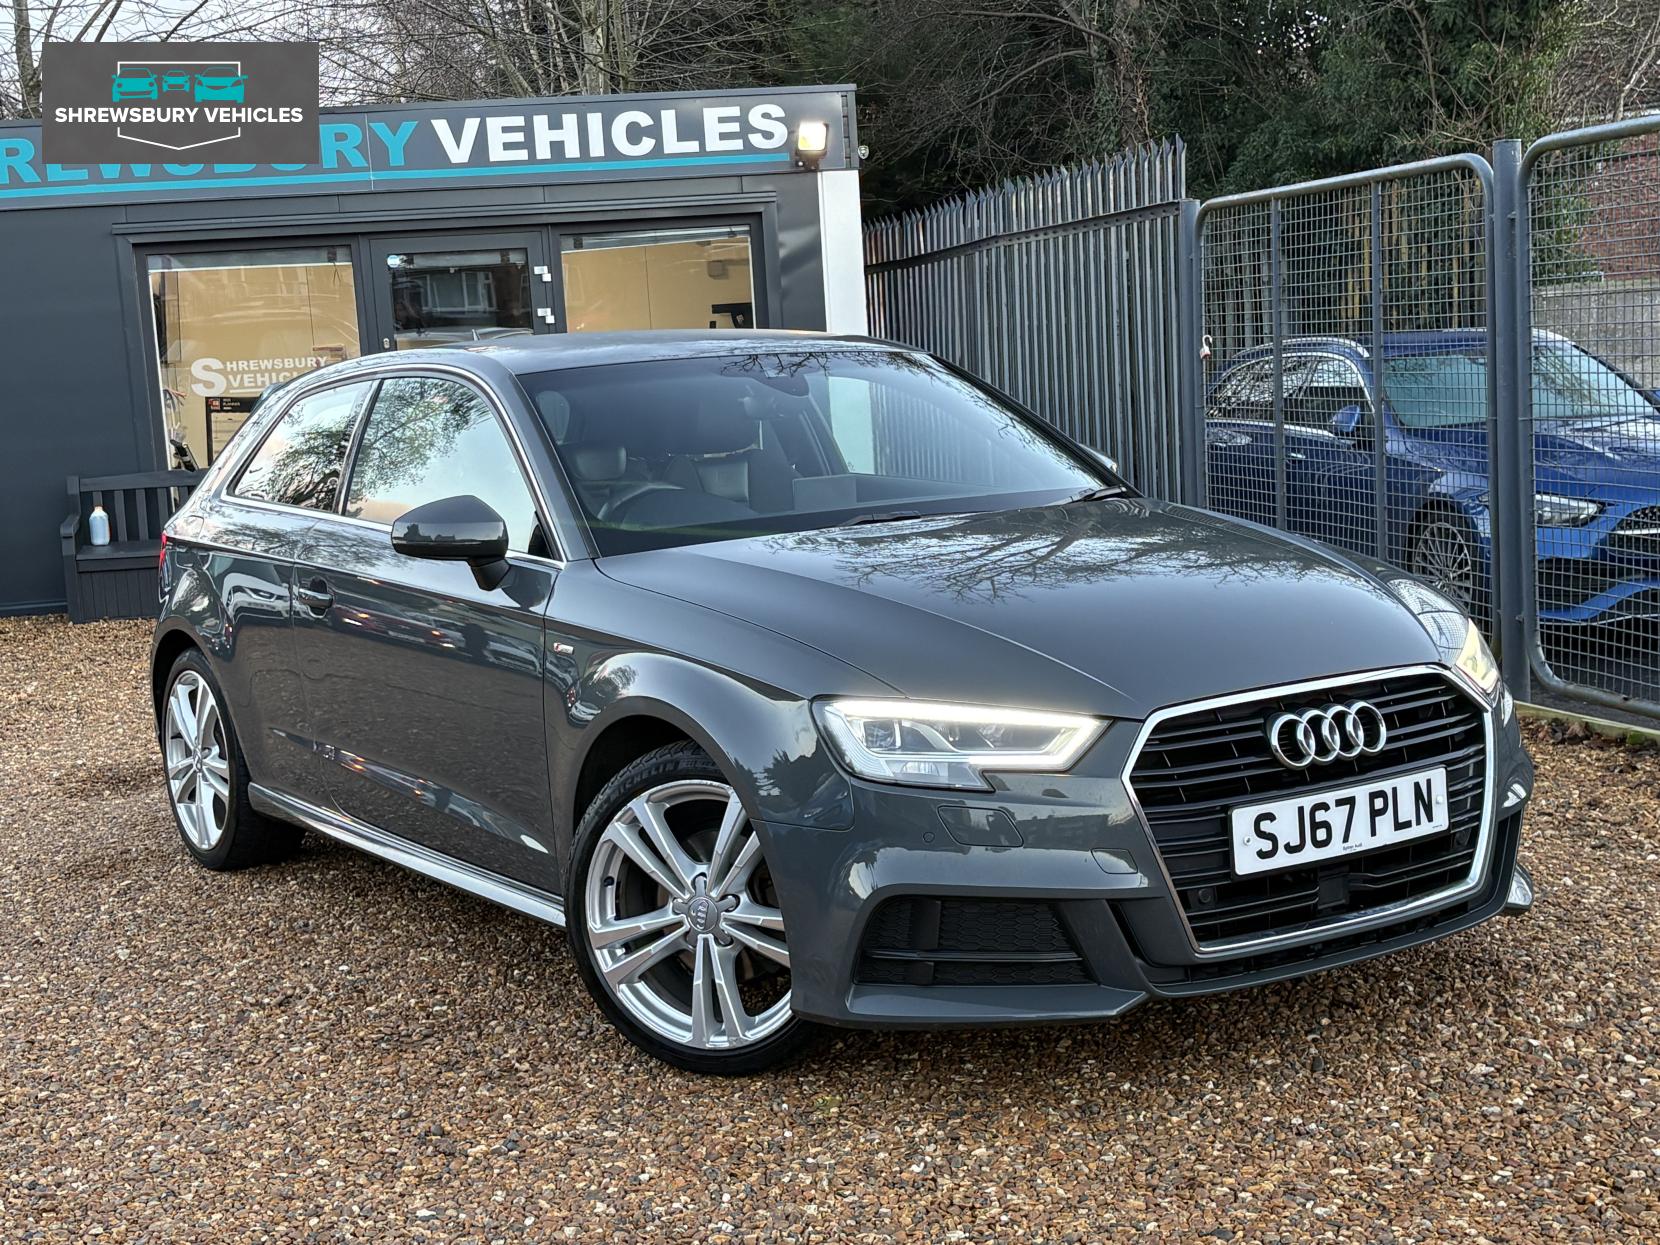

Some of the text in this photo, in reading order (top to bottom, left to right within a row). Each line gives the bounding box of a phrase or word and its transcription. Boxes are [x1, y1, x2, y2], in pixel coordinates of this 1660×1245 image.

[430, 103, 789, 164] VEHICLES
[191, 356, 327, 396] SHREWSBURY
[1254, 779, 1433, 859] SJ67 PLN
